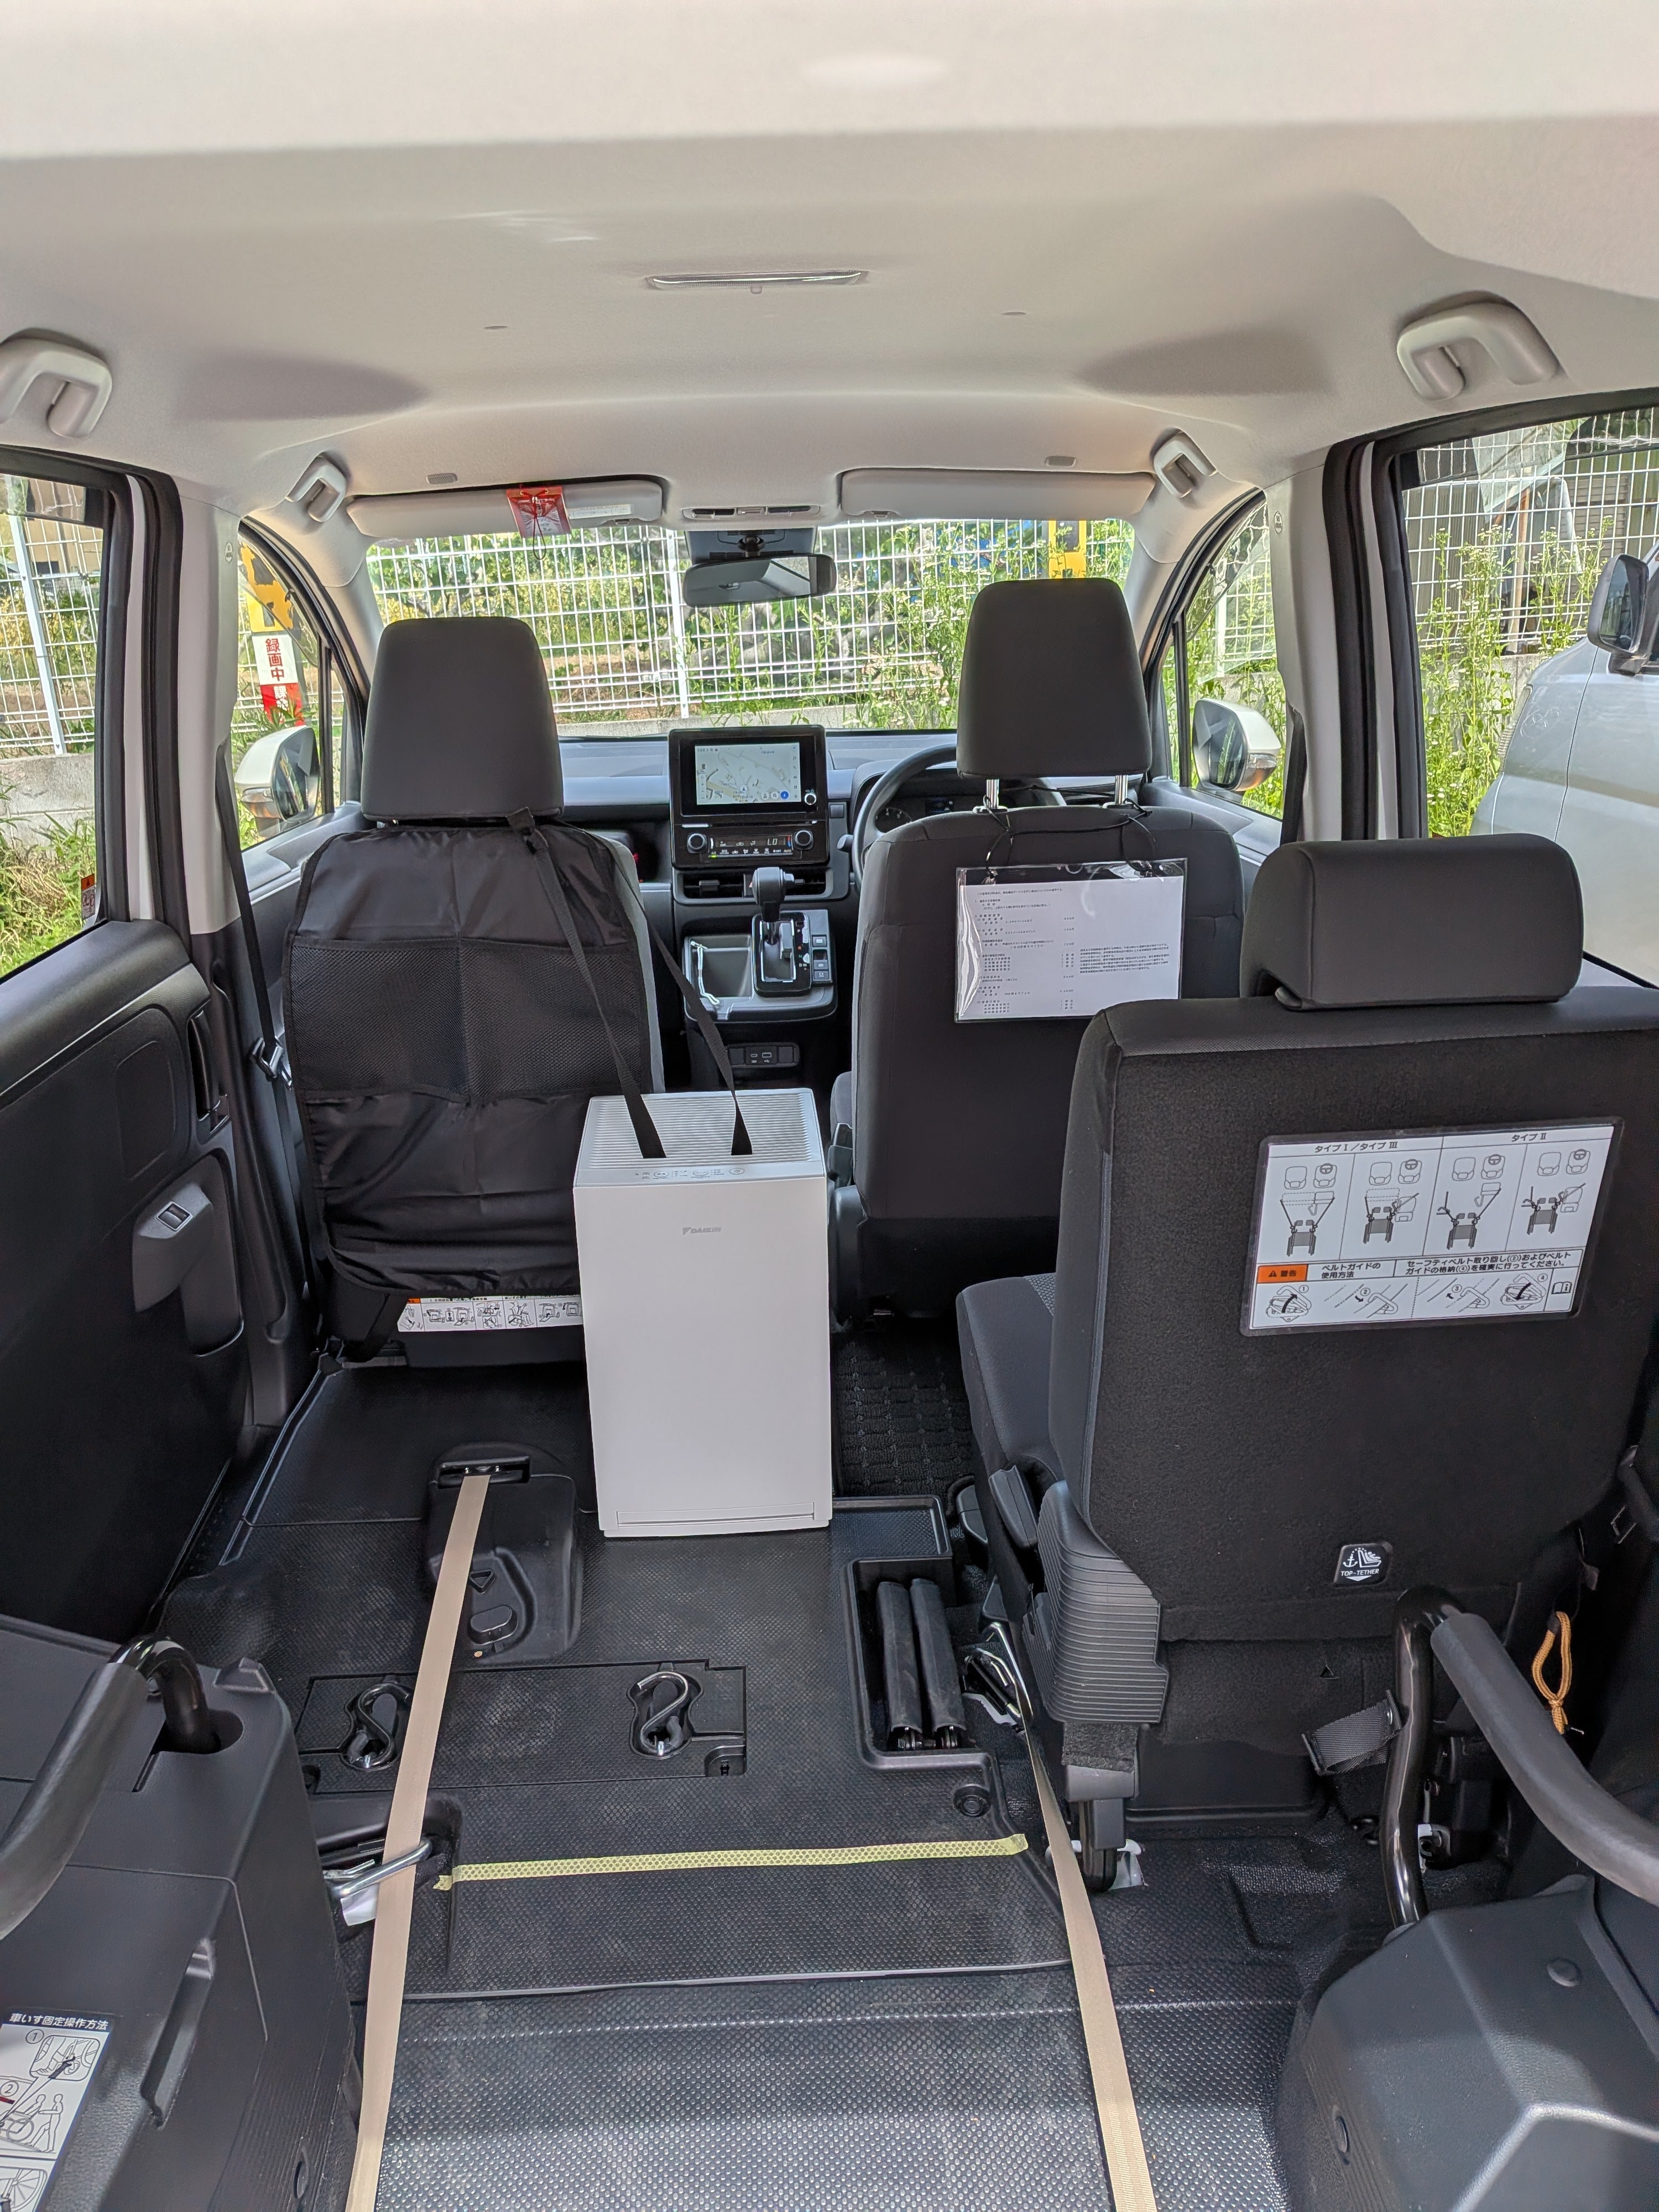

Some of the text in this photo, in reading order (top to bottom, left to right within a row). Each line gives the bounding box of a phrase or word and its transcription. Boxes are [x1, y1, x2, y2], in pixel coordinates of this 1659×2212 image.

[265, 638, 285, 682] 録画中
[1322, 1262, 1381, 1271] ベルトガイドの
[1340, 1568, 1380, 1577] TOP-TETHER
[9, 2012, 109, 2031] 車いす固定操作方法
